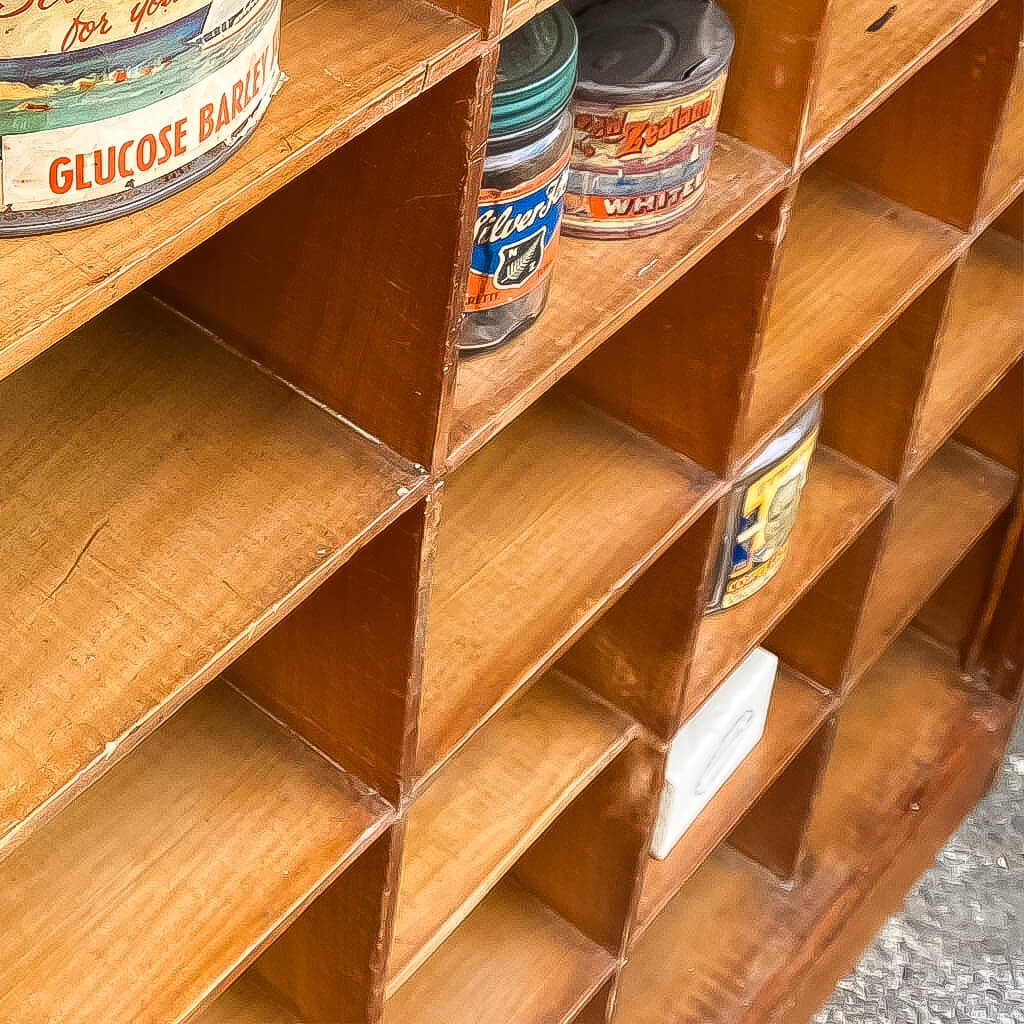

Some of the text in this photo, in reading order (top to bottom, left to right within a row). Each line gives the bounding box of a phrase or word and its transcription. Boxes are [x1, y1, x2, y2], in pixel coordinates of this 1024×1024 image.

[61, 9, 112, 52] for
[49, 117, 188, 194] GLUCOSE
[198, 45, 269, 143] BARLEY
